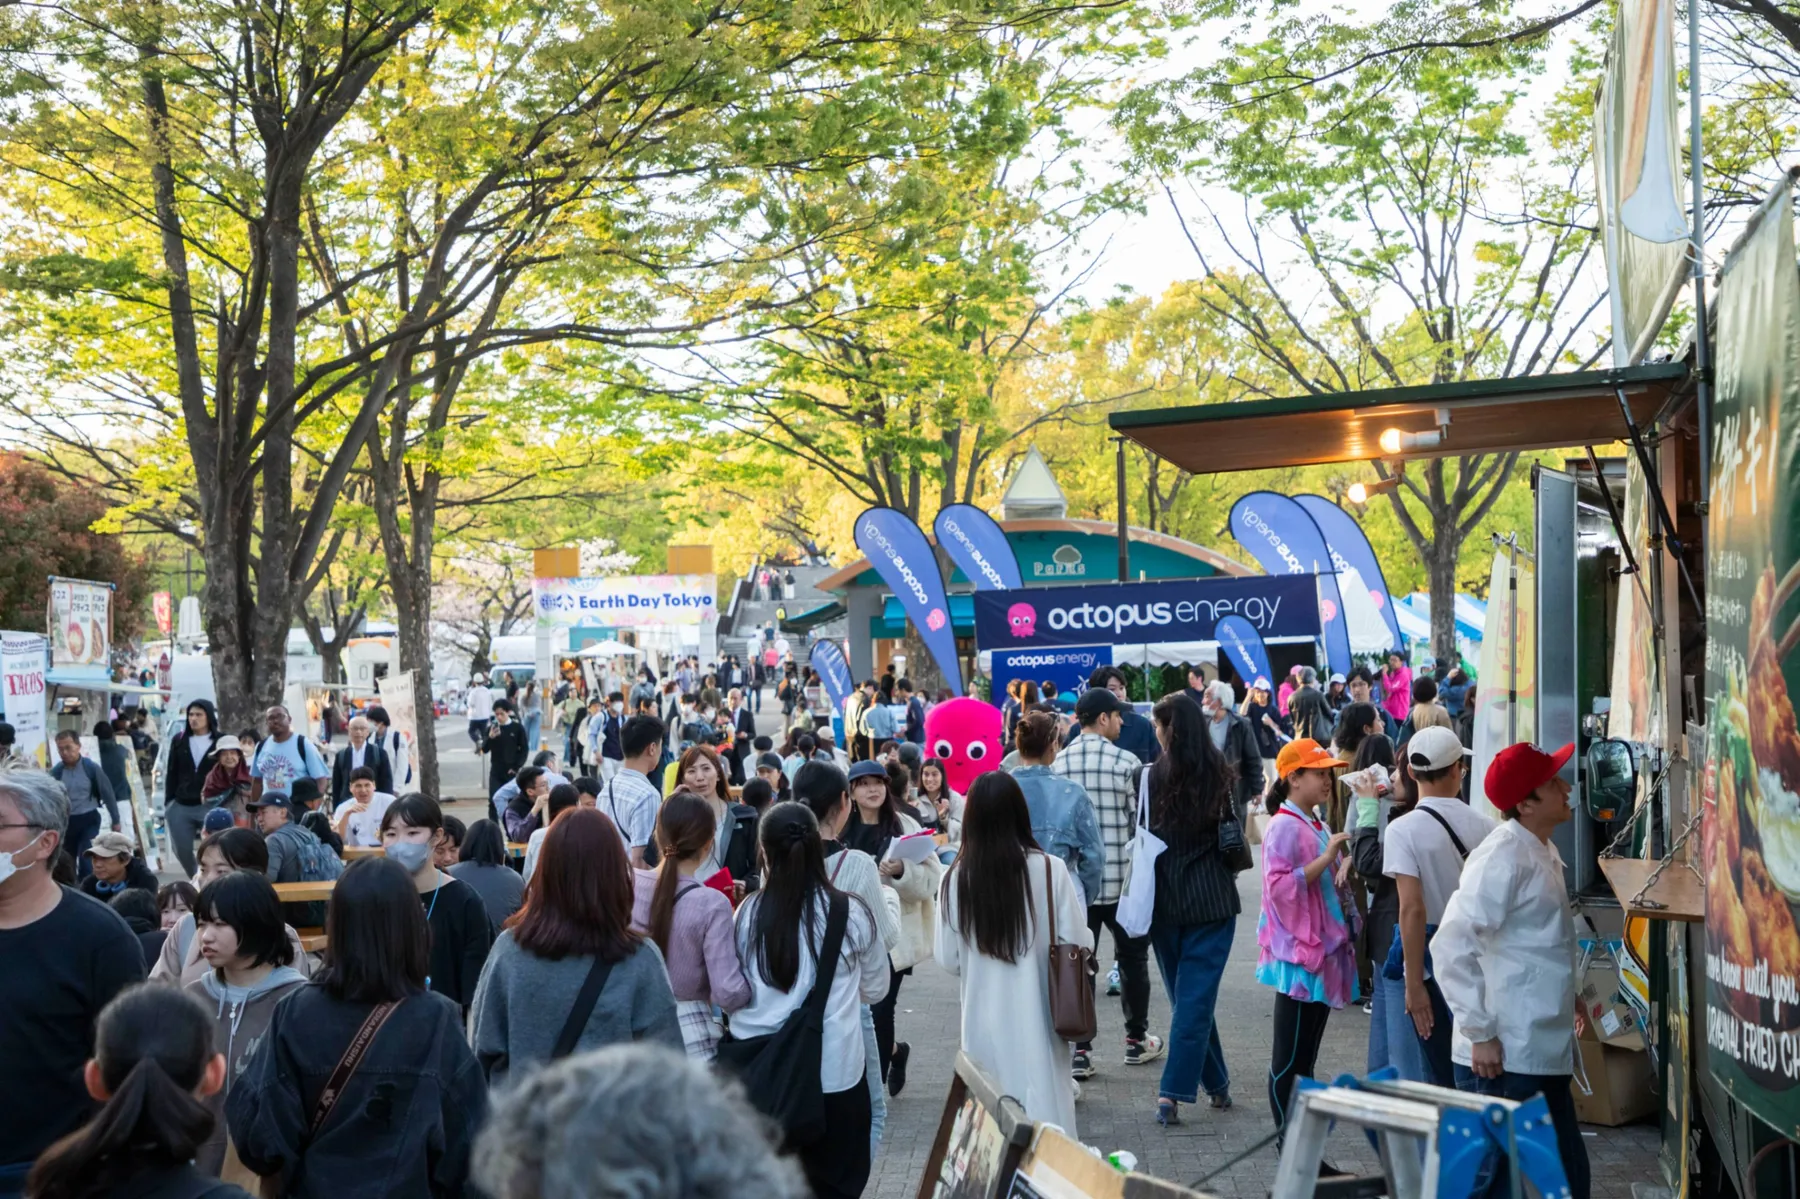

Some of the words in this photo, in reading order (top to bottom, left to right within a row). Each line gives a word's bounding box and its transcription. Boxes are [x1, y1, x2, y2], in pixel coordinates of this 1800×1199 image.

[579, 595, 625, 609] Earth
[628, 594, 660, 610] Day
[663, 593, 712, 609] Tokyo
[1048, 602, 1172, 634] octopus
[1175, 596, 1282, 630] energy
[1006, 654, 1056, 669] octopus
[1055, 652, 1096, 668] energy
[4, 671, 45, 697] TACOS
[1743, 957, 1770, 999] until
[1771, 973, 1800, 1024] you
[1742, 1020, 1777, 1073] FRIED
